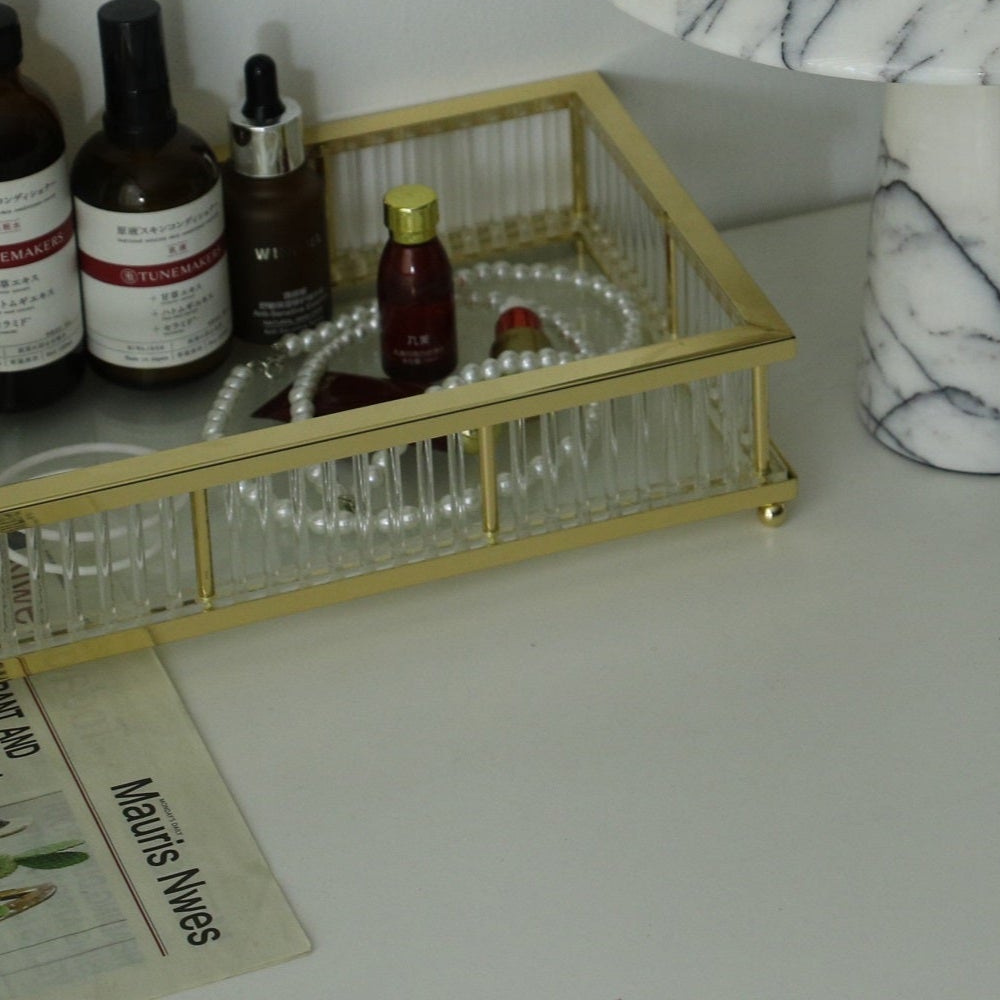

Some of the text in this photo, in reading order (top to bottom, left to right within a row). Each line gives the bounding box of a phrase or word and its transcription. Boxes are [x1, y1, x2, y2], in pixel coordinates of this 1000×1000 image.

[0, 231, 66, 263] EMAKERS
[0, 726, 41, 760] AND
[110, 777, 221, 946] Mauris Nwes
